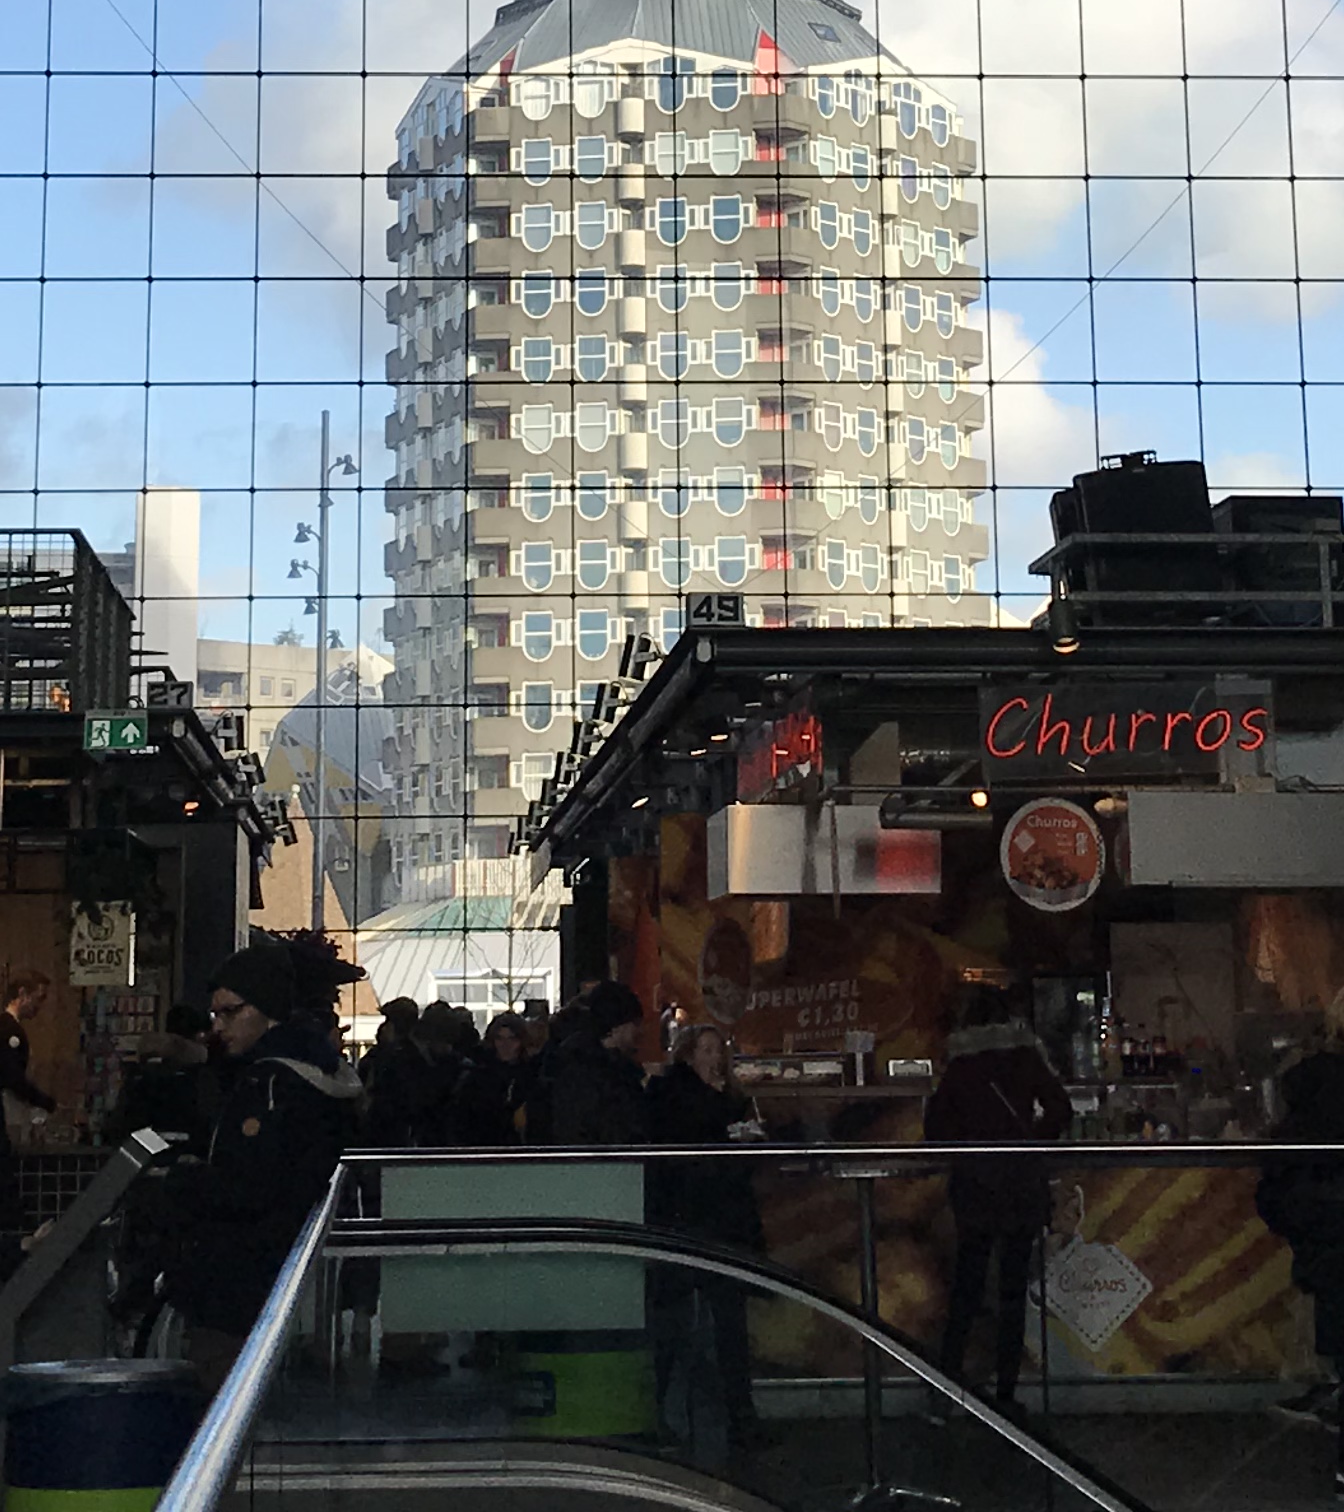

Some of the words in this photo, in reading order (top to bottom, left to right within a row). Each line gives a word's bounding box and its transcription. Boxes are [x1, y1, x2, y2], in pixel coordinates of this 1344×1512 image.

[693, 595, 739, 621] 49
[149, 684, 188, 704] 27
[985, 692, 1269, 759] Churros
[1026, 814, 1078, 828] Churros
